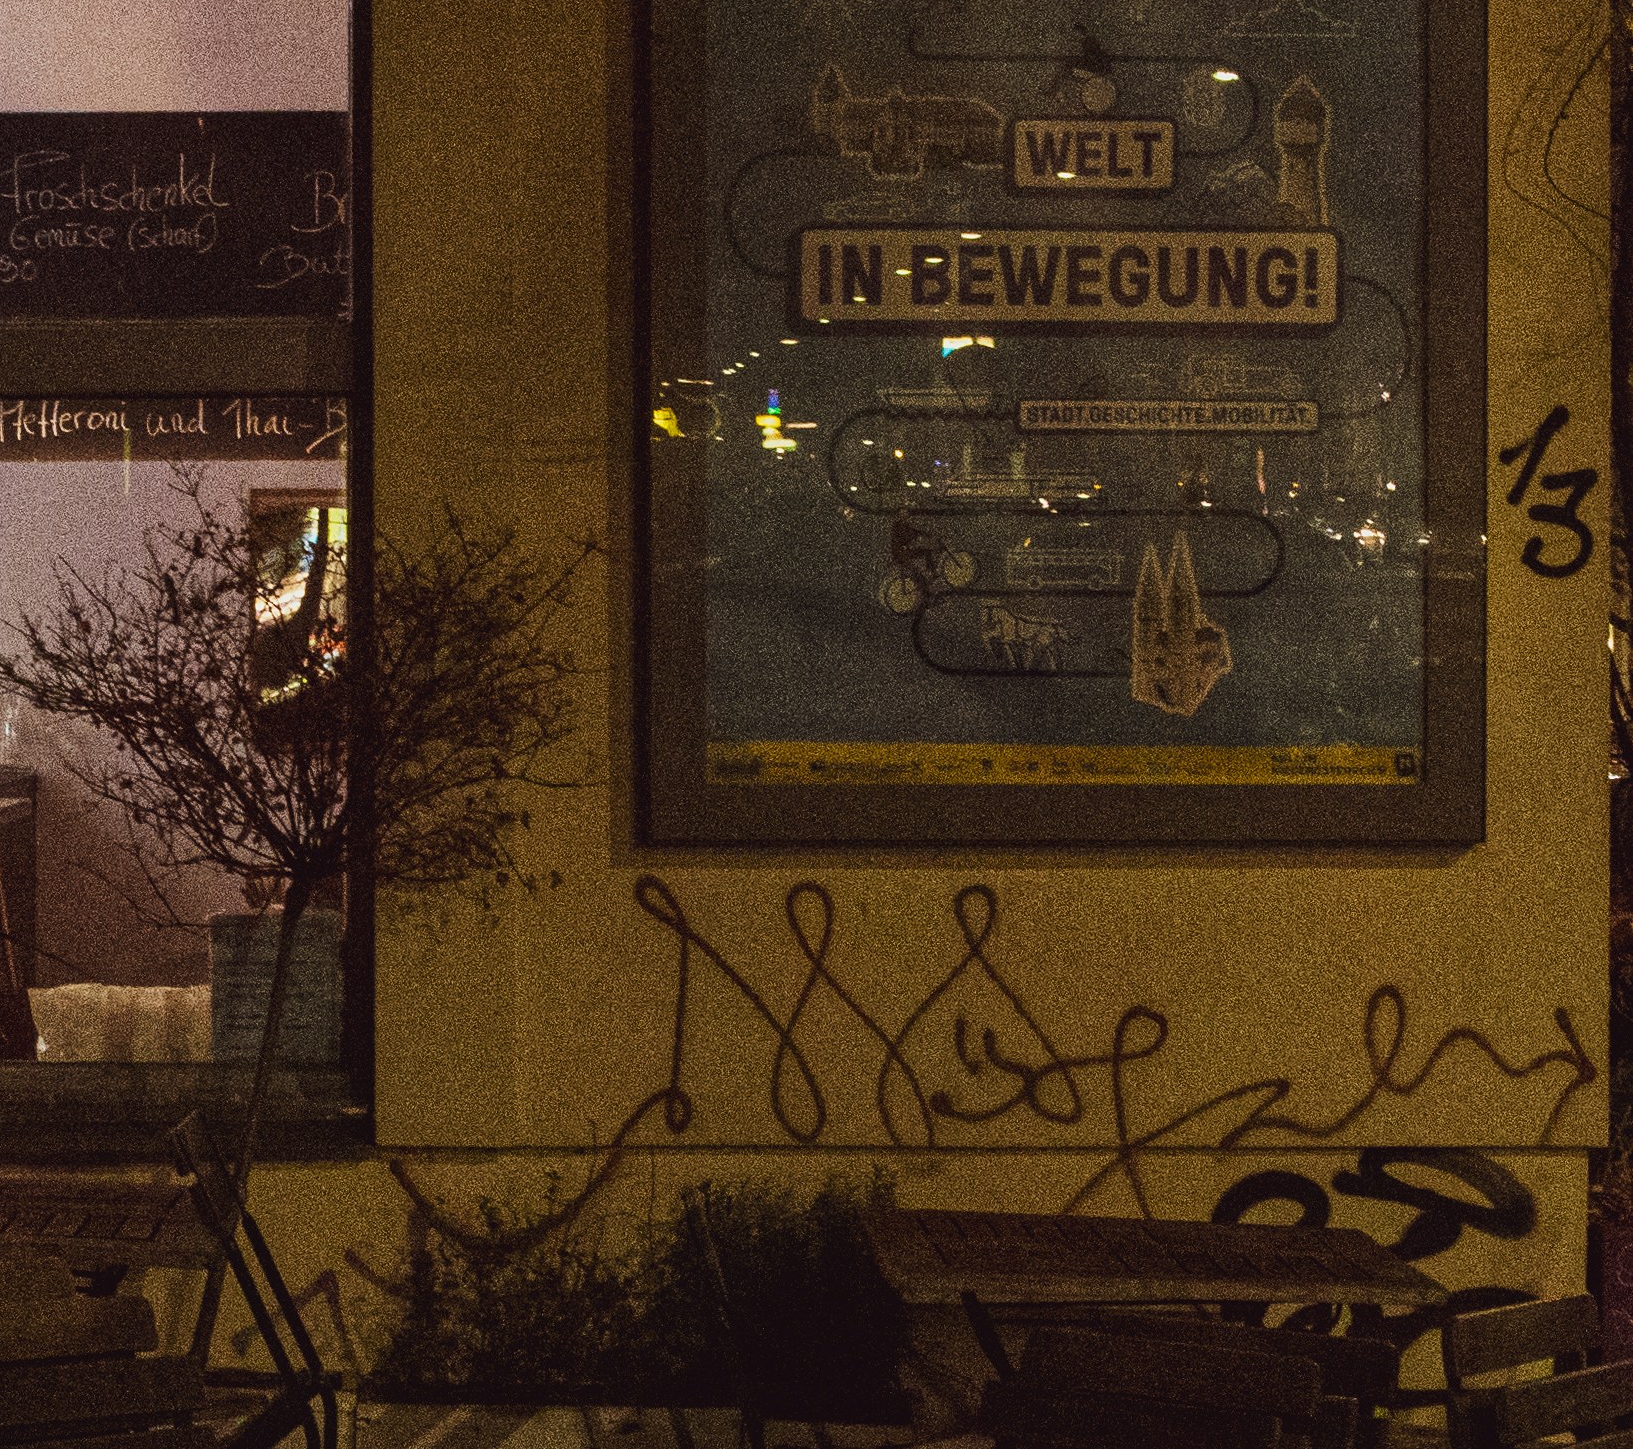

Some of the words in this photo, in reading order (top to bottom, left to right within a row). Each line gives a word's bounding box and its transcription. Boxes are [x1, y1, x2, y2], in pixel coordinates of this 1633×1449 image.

[1027, 131, 1163, 178] WELT
[818, 246, 883, 306] IN
[910, 246, 1319, 308] BEWEGUNG!
[146, 400, 208, 437] und
